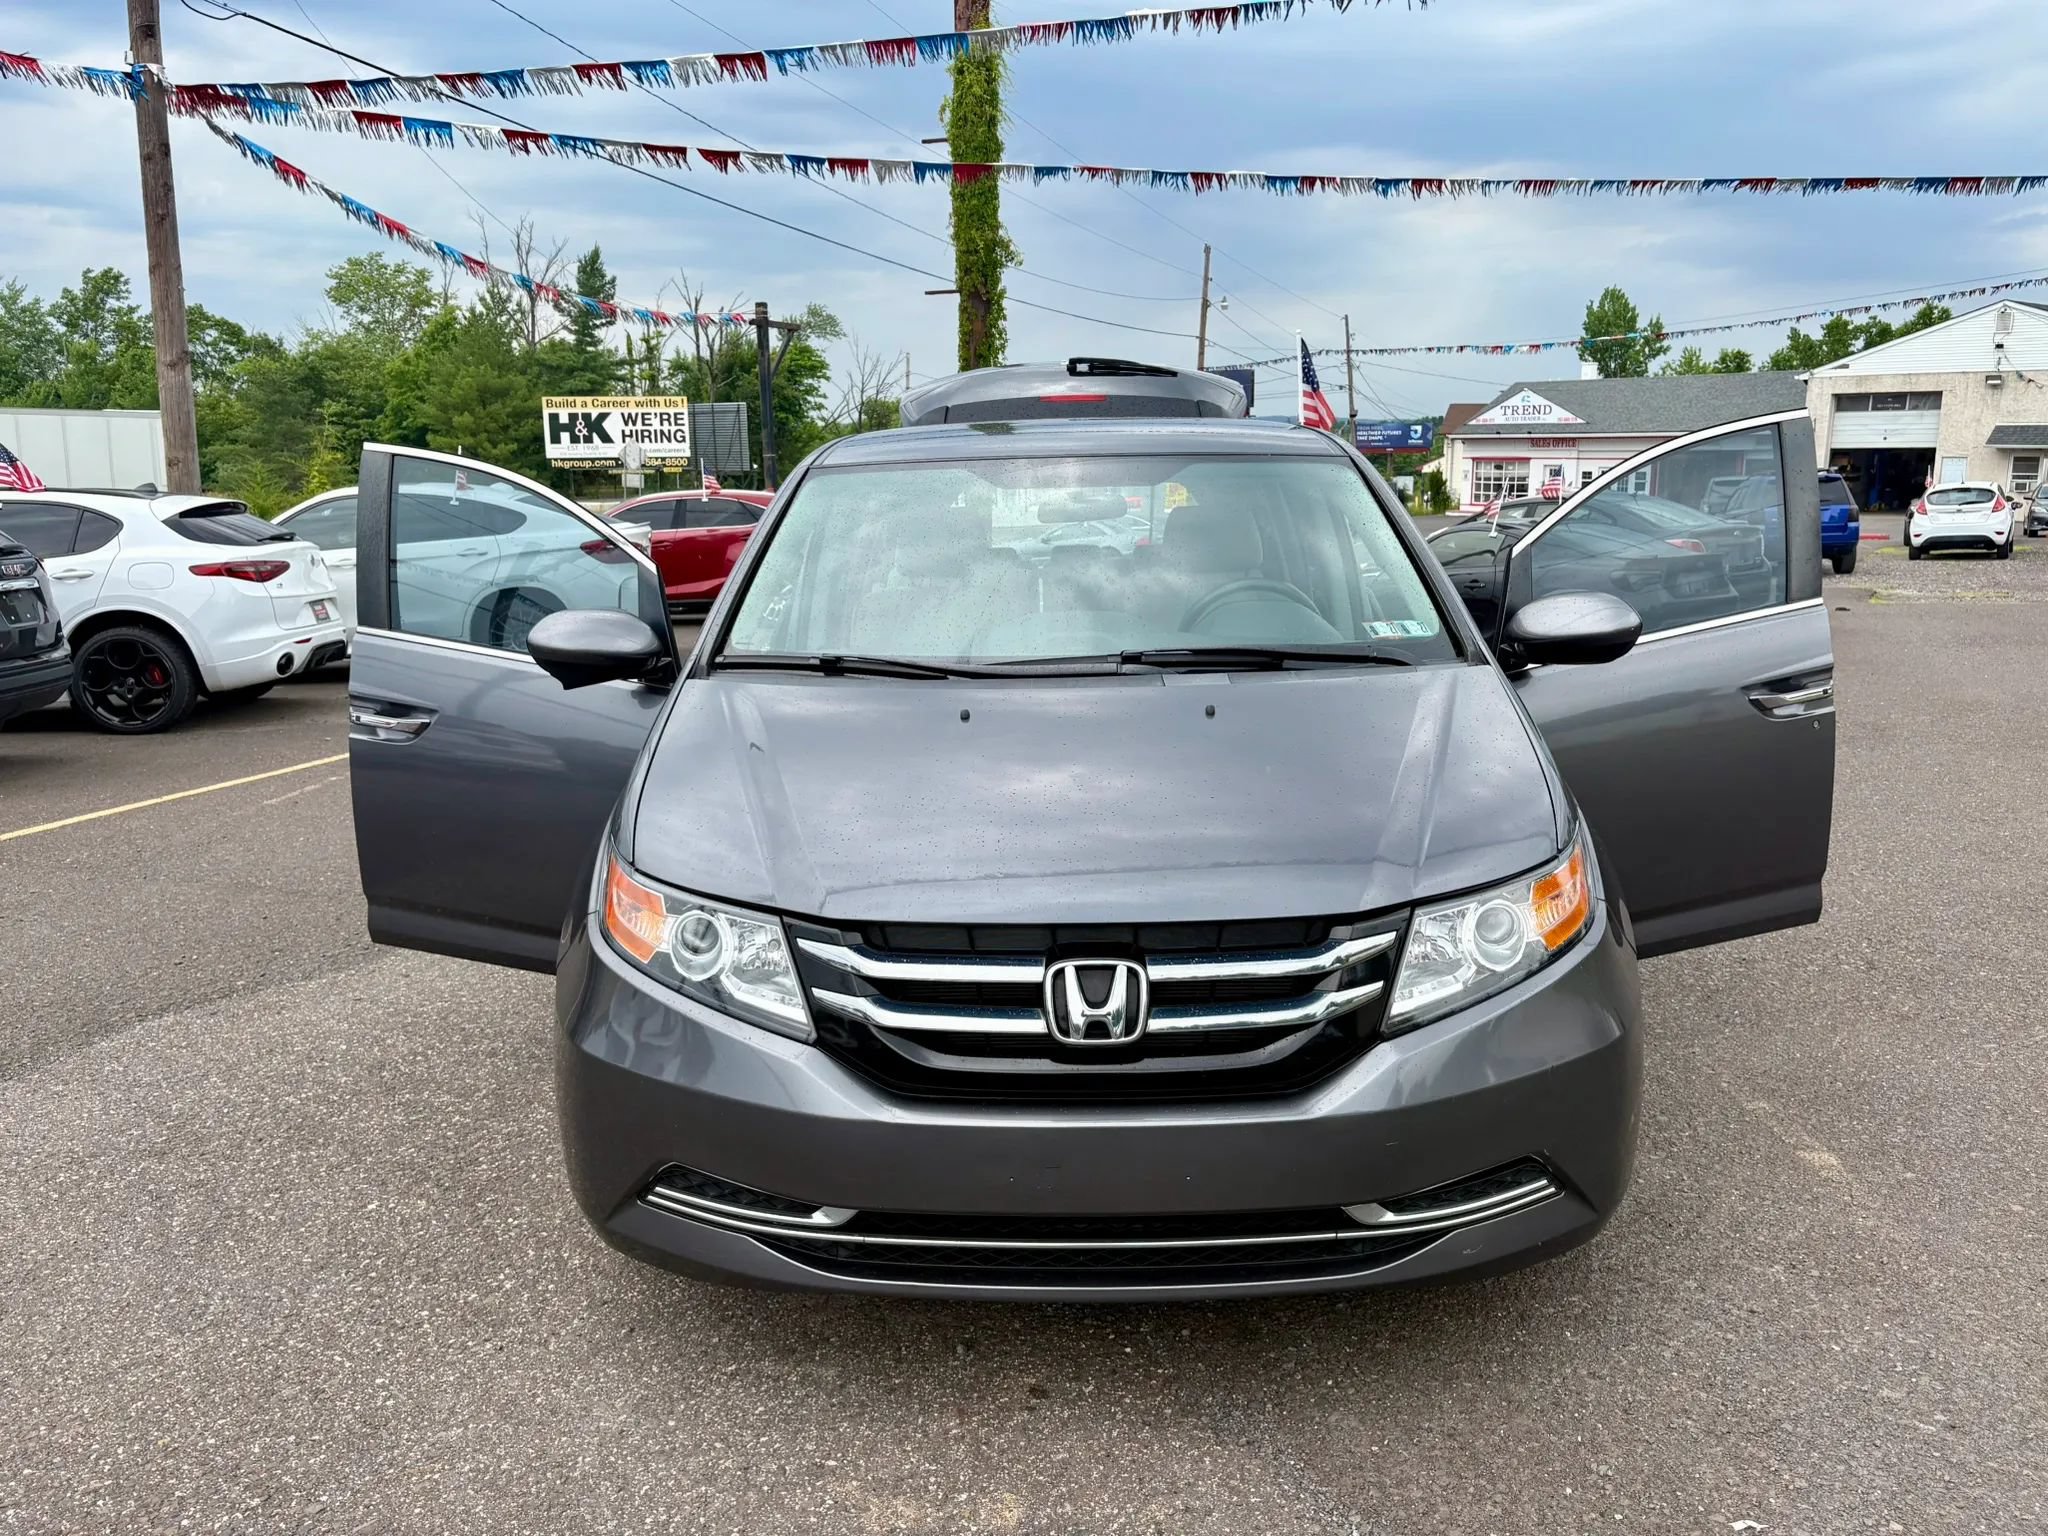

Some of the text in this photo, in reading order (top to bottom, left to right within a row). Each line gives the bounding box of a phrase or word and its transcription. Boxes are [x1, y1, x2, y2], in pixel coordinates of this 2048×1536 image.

[545, 398, 577, 409] Build
[580, 400, 588, 408] a
[591, 398, 631, 409] Career
[634, 398, 660, 408] with
[1500, 404, 1553, 416] TREND
[620, 412, 686, 427] WE'RE
[548, 412, 614, 444] H&K
[621, 428, 687, 444] HIRING
[1529, 439, 1578, 449] SALES OFFICE
[551, 458, 688, 469] hkgroup.com 584-8500
